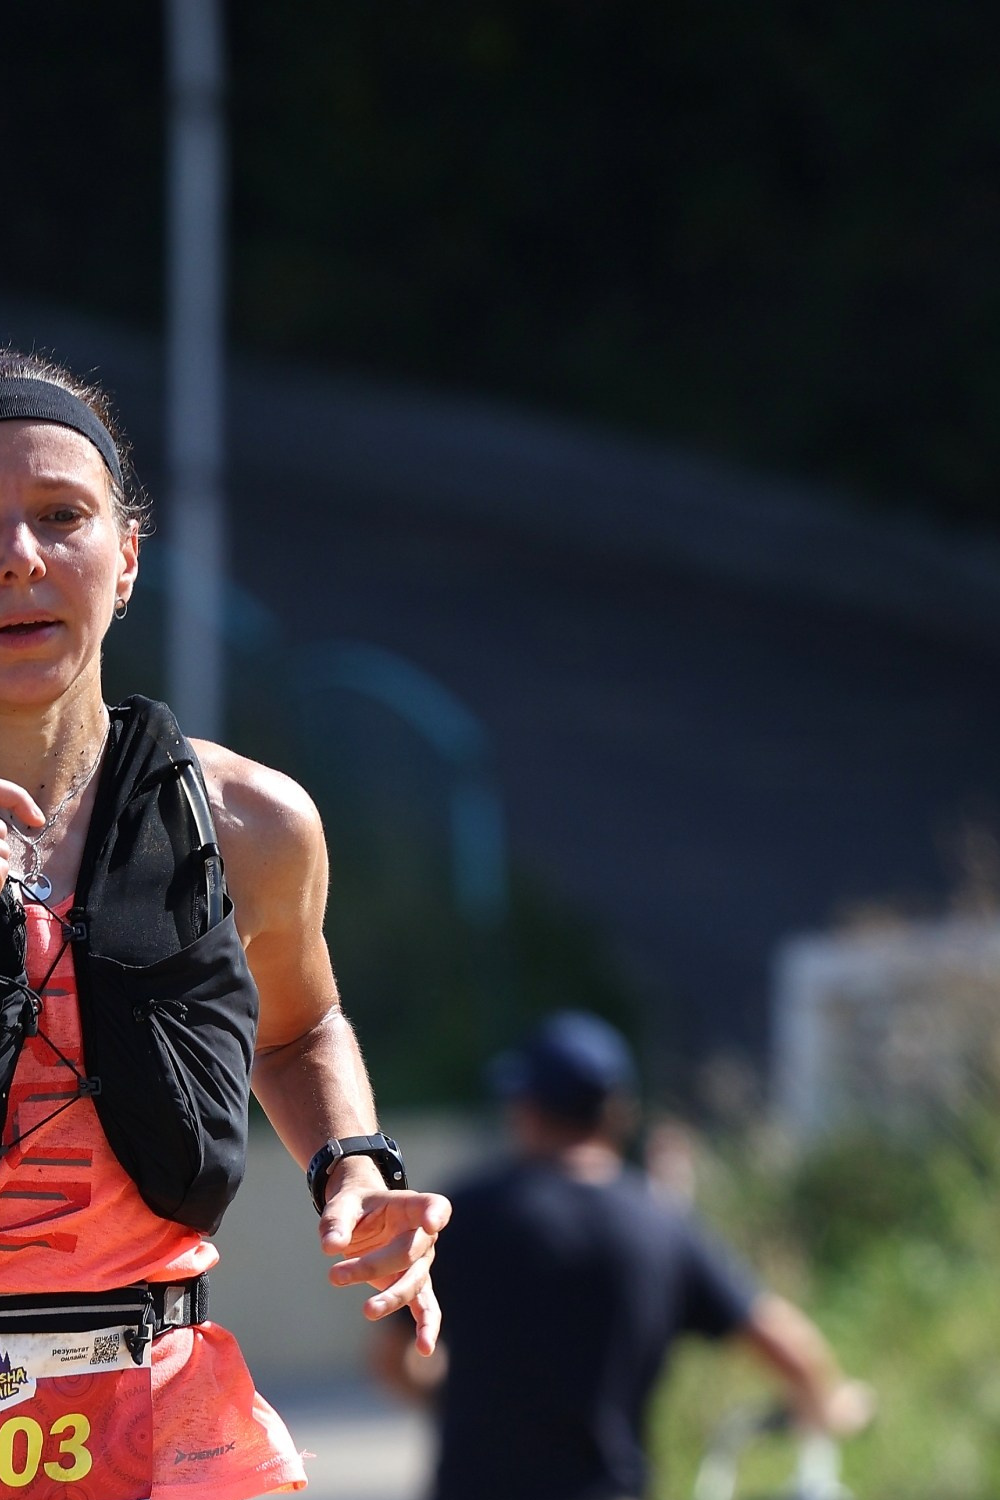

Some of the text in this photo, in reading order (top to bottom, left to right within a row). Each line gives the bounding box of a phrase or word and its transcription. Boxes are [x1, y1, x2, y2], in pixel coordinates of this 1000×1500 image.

[52, 1346, 89, 1357] результат
[60, 1353, 88, 1362] онлайн:
[186, 1441, 236, 1463] DEMIX
